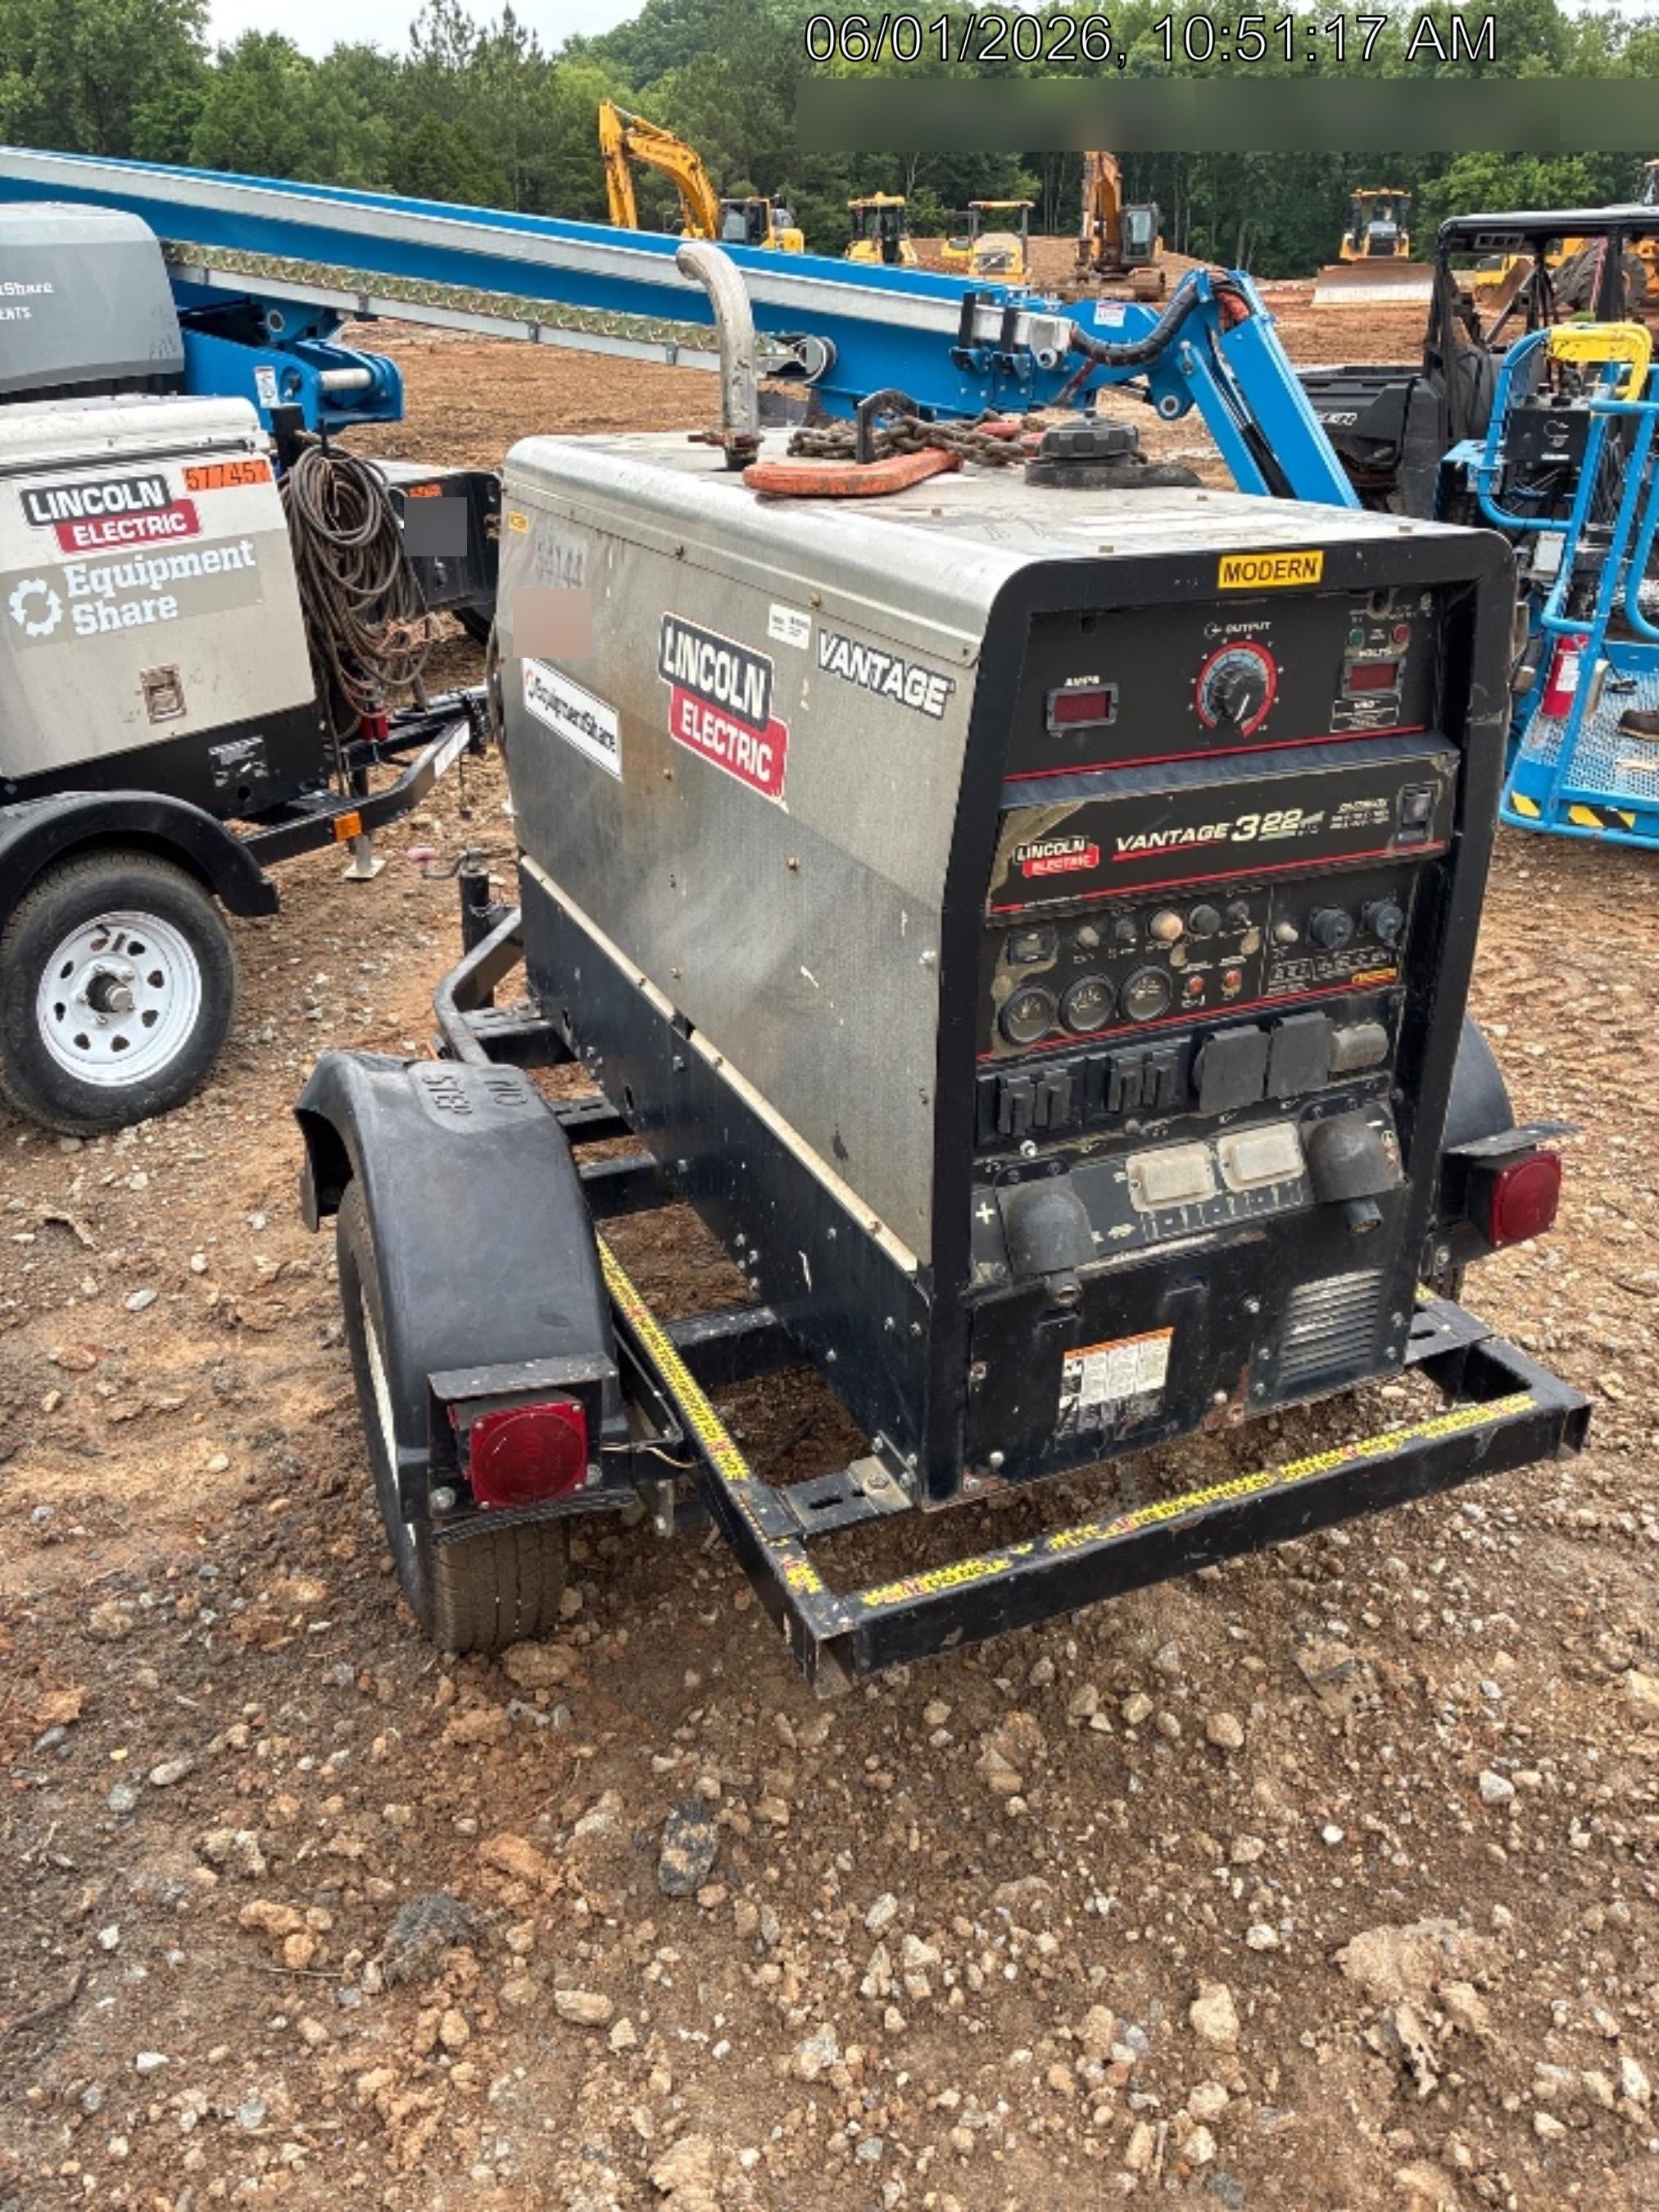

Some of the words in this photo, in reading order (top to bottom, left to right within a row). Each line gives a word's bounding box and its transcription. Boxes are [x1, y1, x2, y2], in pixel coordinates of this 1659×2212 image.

[0, 282, 54, 296] Share
[29, 480, 165, 522] LINCOLN
[72, 512, 188, 546] ELECTRIC
[62, 539, 256, 599] Equipment
[1222, 558, 1318, 582] MODERN
[71, 594, 179, 637] Share
[1226, 621, 1271, 634] OUTPUT
[664, 625, 766, 721] LINCOLN
[819, 627, 952, 720] VANTAGE
[681, 698, 773, 783] ELECTRIC
[1017, 838, 1086, 860] LINCOLN
[1116, 822, 1234, 852] VANTAGE
[1231, 808, 1303, 842] 322
[1031, 855, 1091, 875] ELECTRIC
